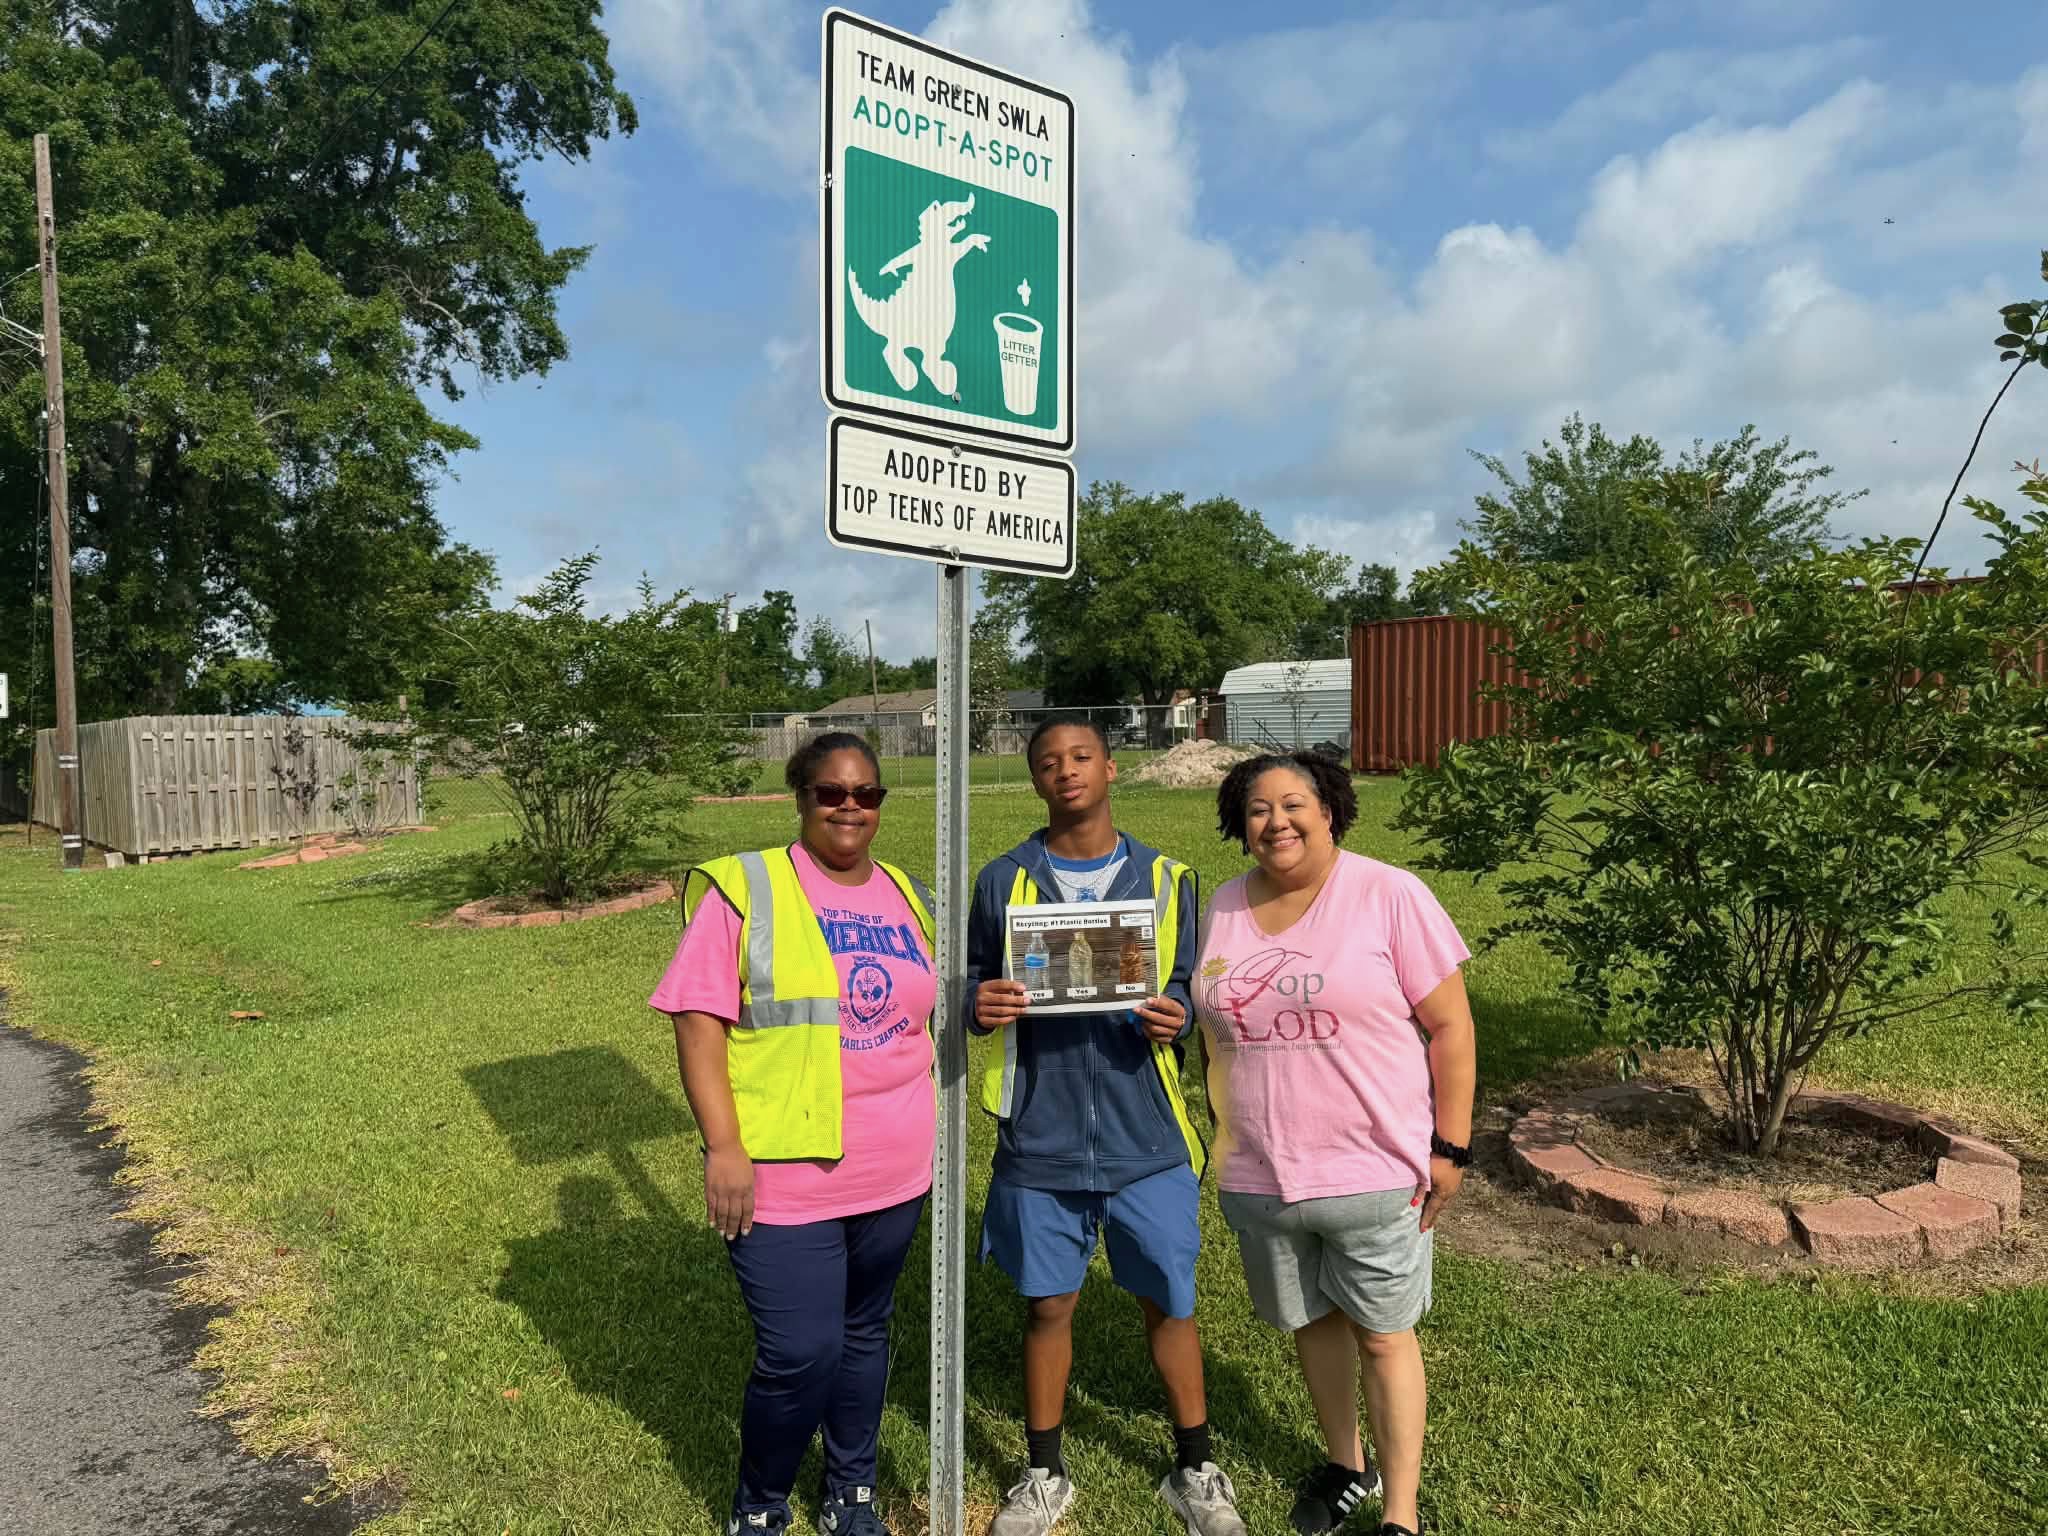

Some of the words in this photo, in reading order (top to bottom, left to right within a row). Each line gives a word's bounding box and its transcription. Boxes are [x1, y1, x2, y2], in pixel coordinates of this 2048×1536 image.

[857, 50, 915, 96] TEAM
[924, 76, 988, 121] GREEN
[998, 102, 1049, 141] SWLA
[853, 95, 1053, 182] ADOPT-A-SPOT
[1001, 351, 1038, 368] GETTER
[1003, 337, 1035, 355] LITTER
[884, 449, 986, 493] ADOPTED
[999, 471, 1027, 499] BY
[842, 484, 878, 515] TOP
[889, 493, 944, 528] TEENS
[954, 505, 976, 532] OF
[986, 510, 1064, 545] AMERICA
[822, 907, 839, 917] TOP
[872, 916, 884, 924] OF
[816, 915, 931, 975] MERICA
[874, 1016, 910, 1047] CHAPTER
